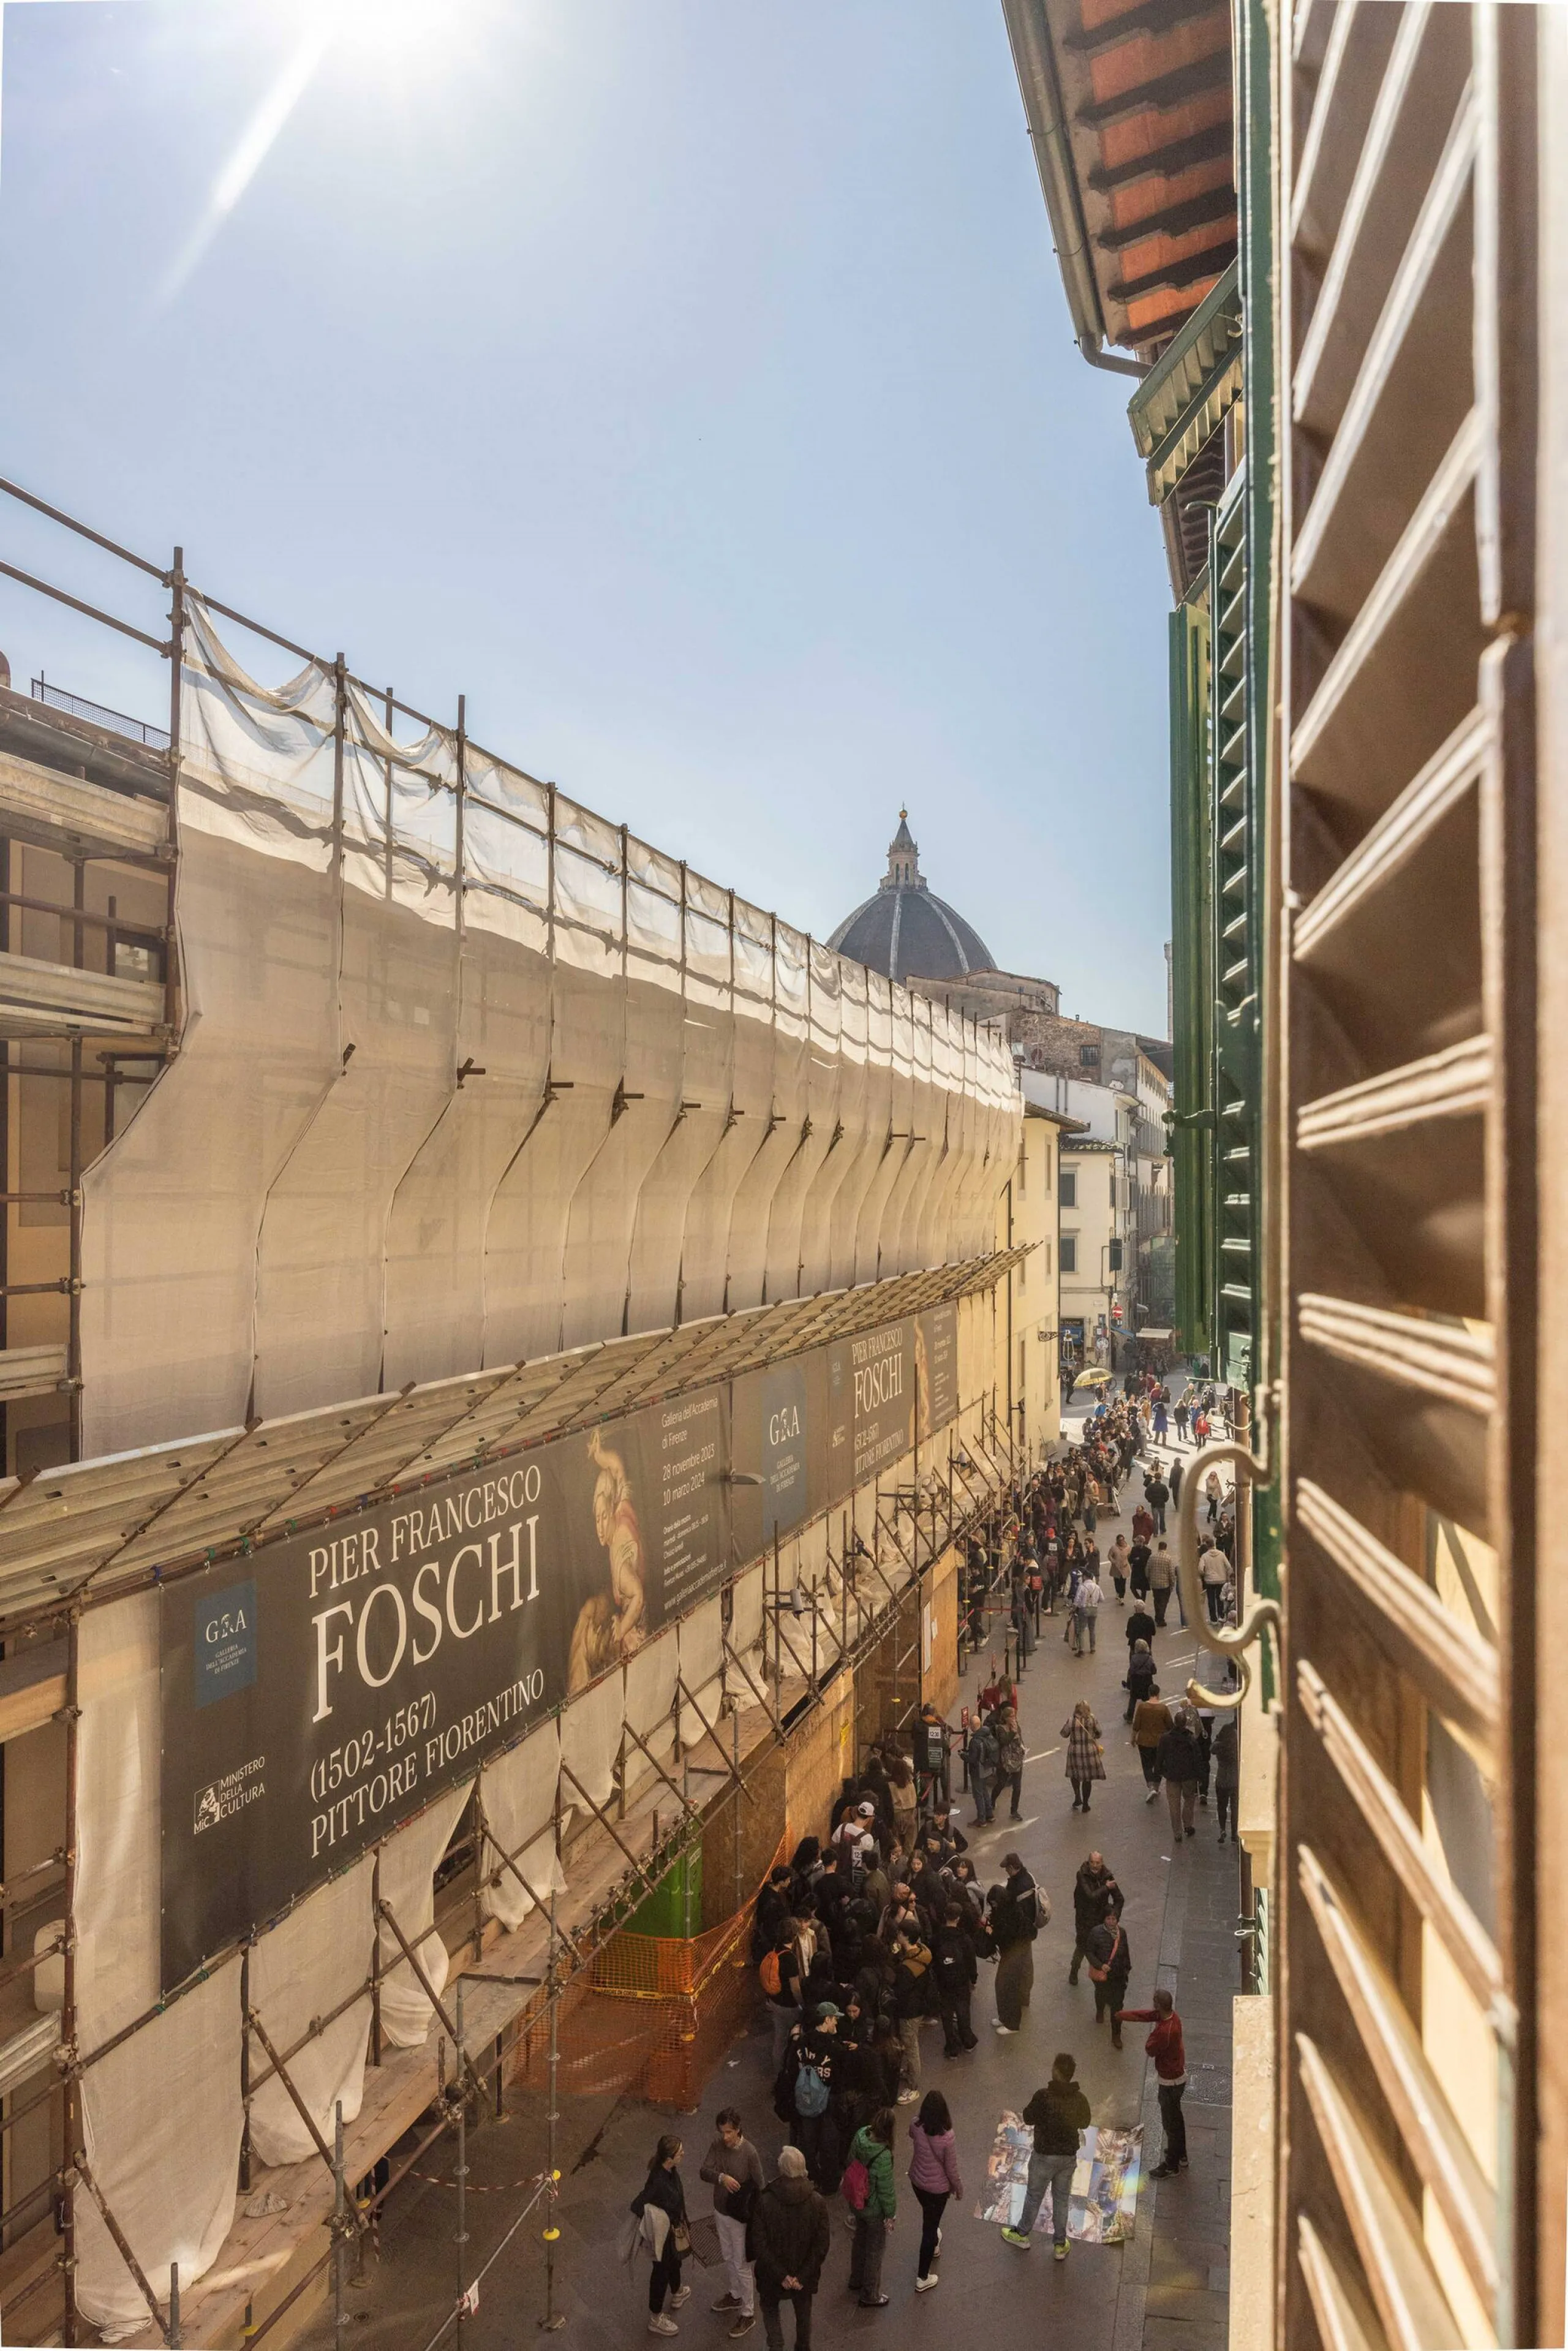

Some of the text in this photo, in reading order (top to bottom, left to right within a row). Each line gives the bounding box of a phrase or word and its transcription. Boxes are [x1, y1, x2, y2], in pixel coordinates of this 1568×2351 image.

[851, 1340, 867, 1365] PIER
[869, 1327, 903, 1359] FRANCESCO
[854, 1352, 902, 1419] FOSCHI
[662, 1411, 683, 1428] Galleria
[662, 1429, 688, 1449] di Firenze
[663, 1443, 715, 1481] 28 novembre 2023
[663, 1471, 705, 1506] 10 marzo 2024
[309, 1465, 541, 1599] PIER FRANCESCO
[311, 1514, 540, 1724] FOSCHI
[311, 1690, 437, 1803] (1502-1567)
[311, 1668, 545, 1859] PITTORE FIORENTINO
[221, 1756, 265, 1791] MINISTERO
[221, 1783, 243, 1803] DELLA
[221, 1783, 265, 1818] CULTURA
